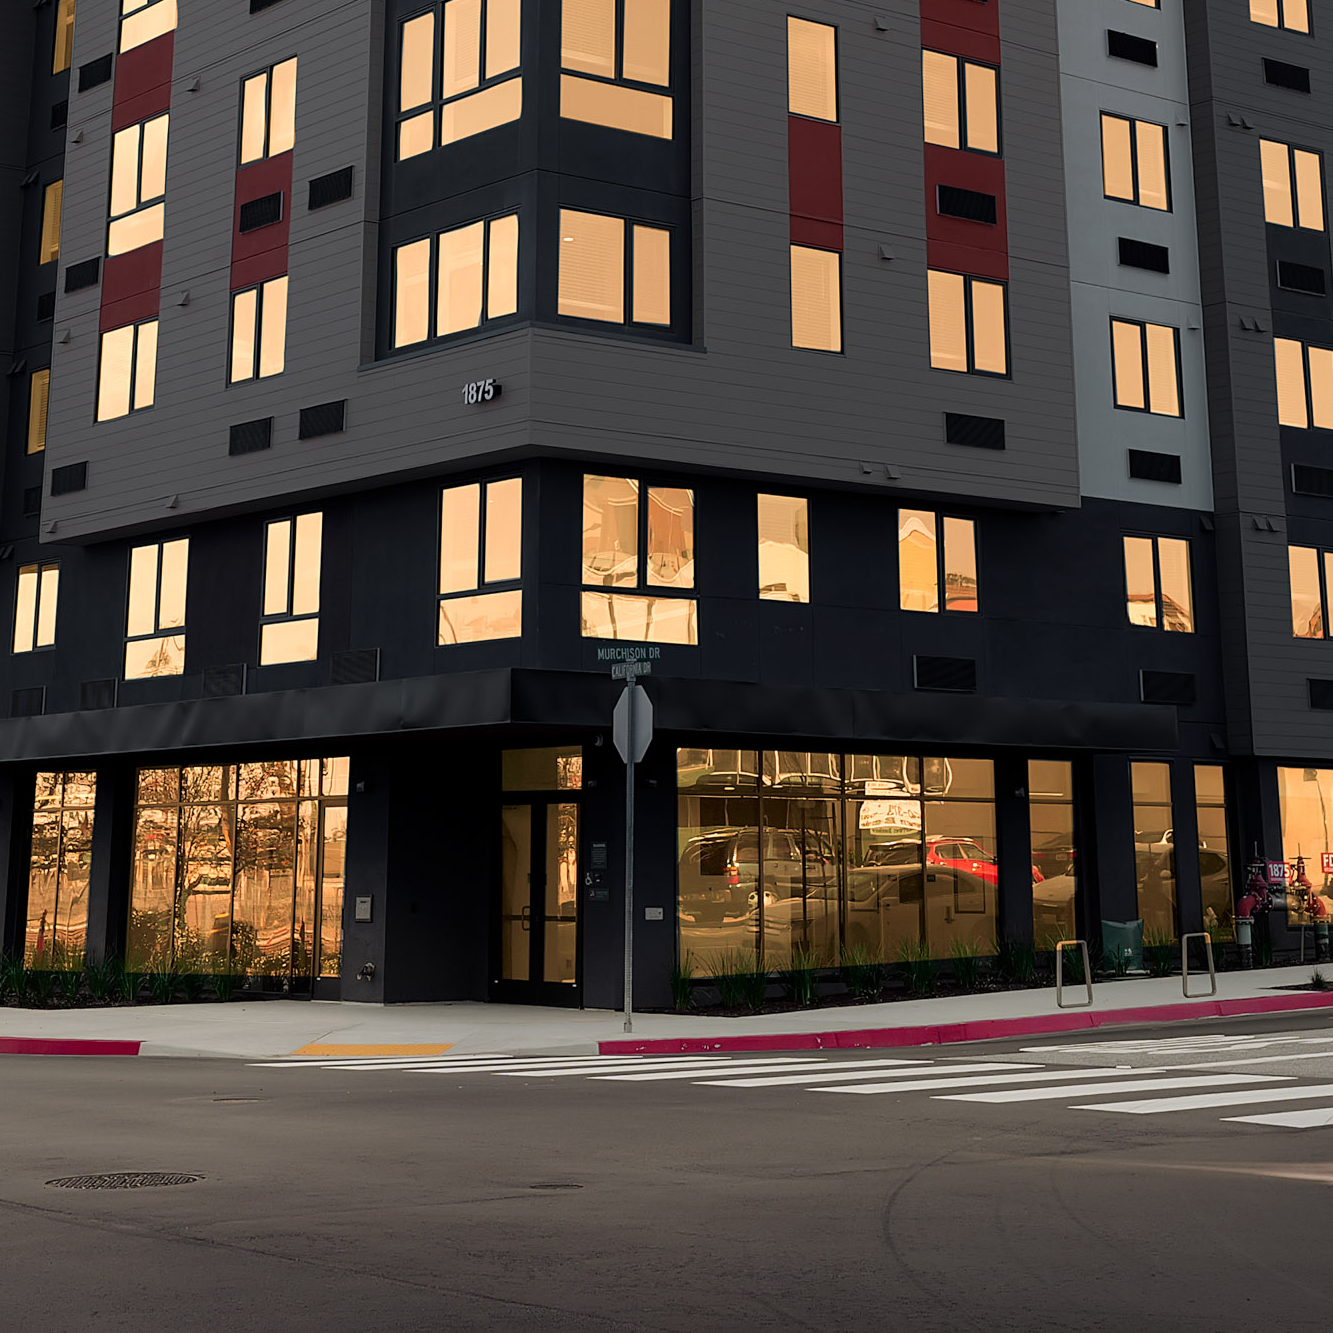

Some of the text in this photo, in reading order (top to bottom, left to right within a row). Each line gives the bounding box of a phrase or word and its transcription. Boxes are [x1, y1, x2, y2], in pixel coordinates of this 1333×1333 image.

[462, 379, 494, 404] 1875
[598, 647, 660, 660] MURCHISON DR
[1268, 863, 1290, 878] 1875
